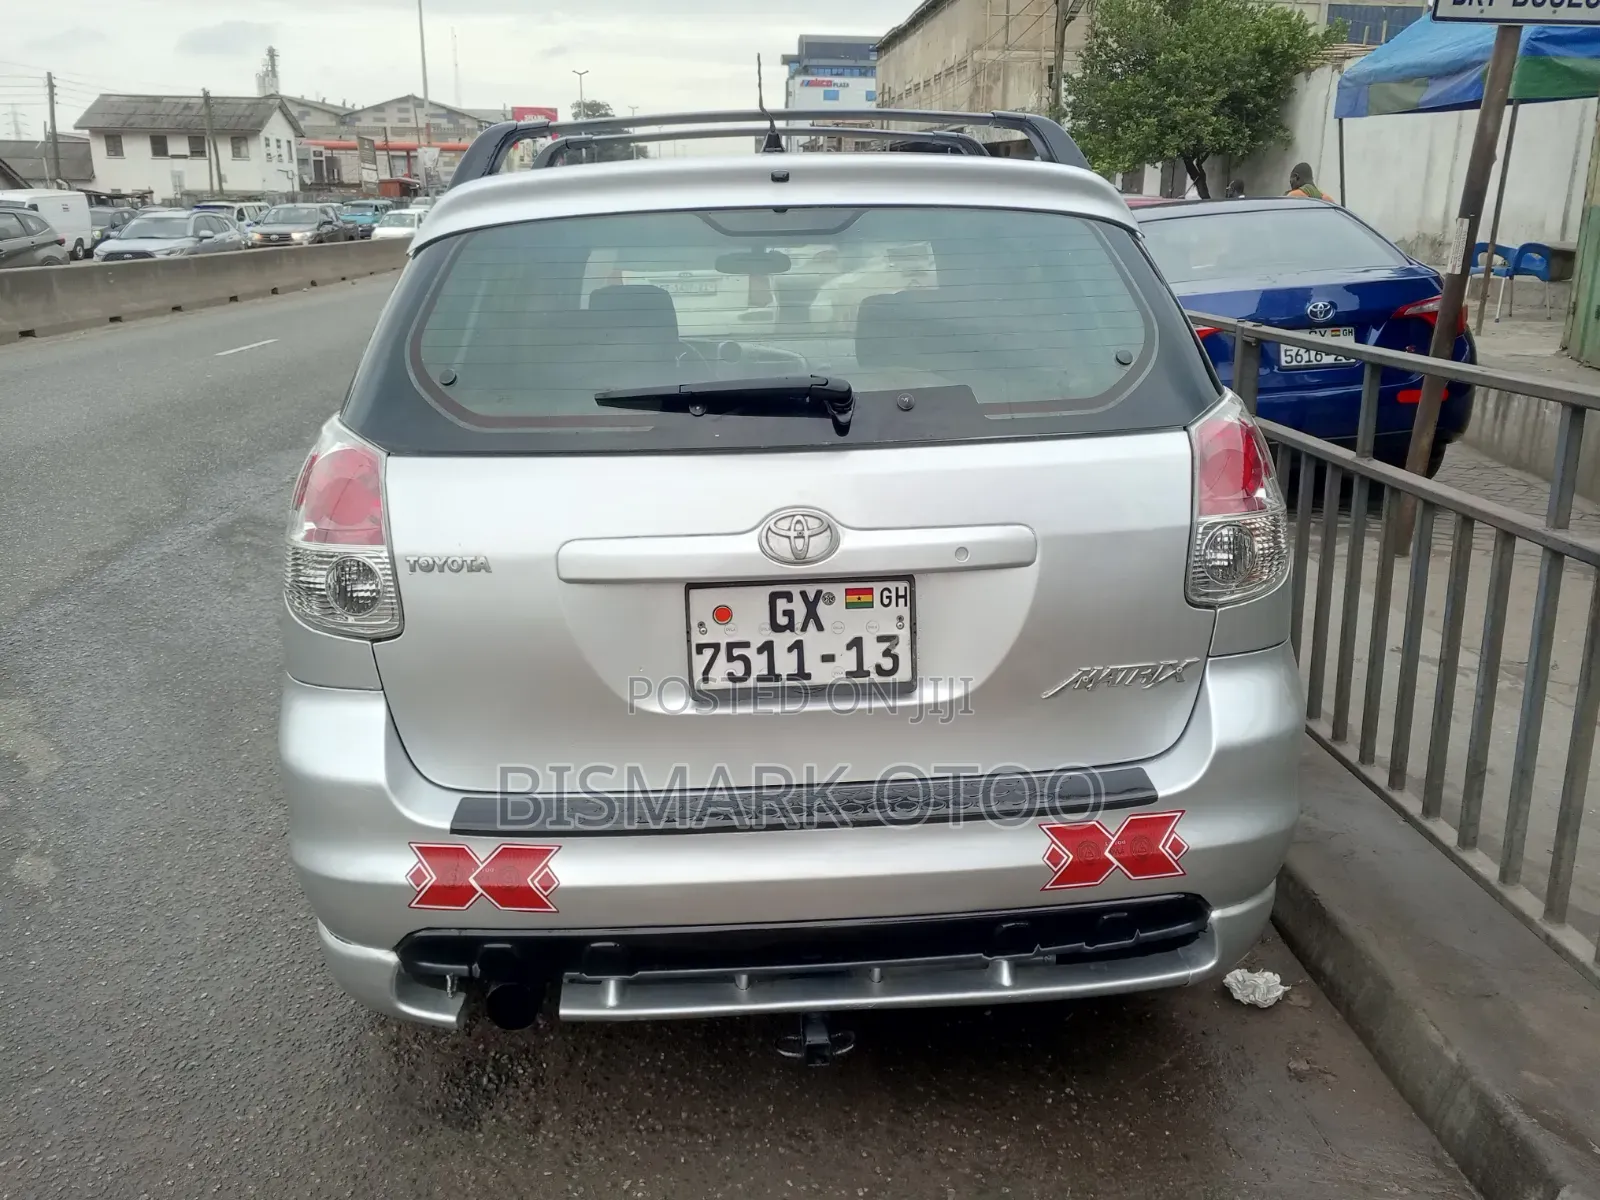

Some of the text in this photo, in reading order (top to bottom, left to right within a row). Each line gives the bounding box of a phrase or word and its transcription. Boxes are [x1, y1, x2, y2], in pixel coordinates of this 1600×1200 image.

[1342, 328, 1354, 337] GH
[1284, 348, 1351, 365] 5616-2
[405, 555, 492, 574] TOYOTA
[879, 586, 908, 608] GH
[768, 589, 825, 633] GX
[695, 634, 900, 684] 7511-13
[1040, 656, 1200, 699] MATRIX
